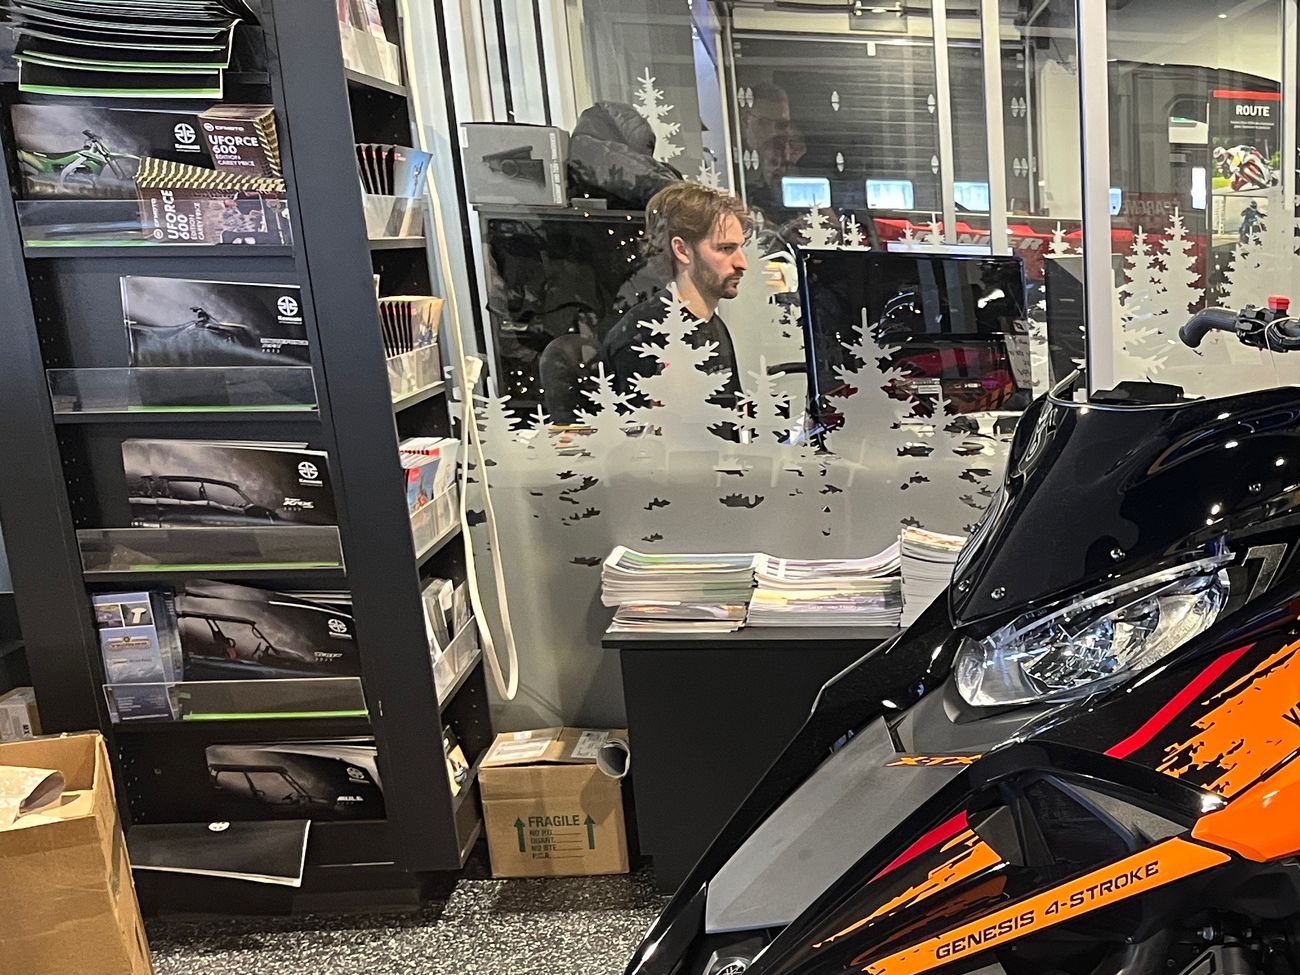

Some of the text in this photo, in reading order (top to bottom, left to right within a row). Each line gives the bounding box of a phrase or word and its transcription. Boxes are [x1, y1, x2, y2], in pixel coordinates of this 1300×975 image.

[1235, 104, 1270, 117] ROUTE
[208, 134, 259, 147] UFORCE
[212, 145, 238, 155] 600
[160, 189, 179, 240] UFORCE
[177, 214, 190, 240] 600
[528, 814, 581, 828] FRAGILE
[934, 860, 1160, 961] GENESIS 4-STROKE
